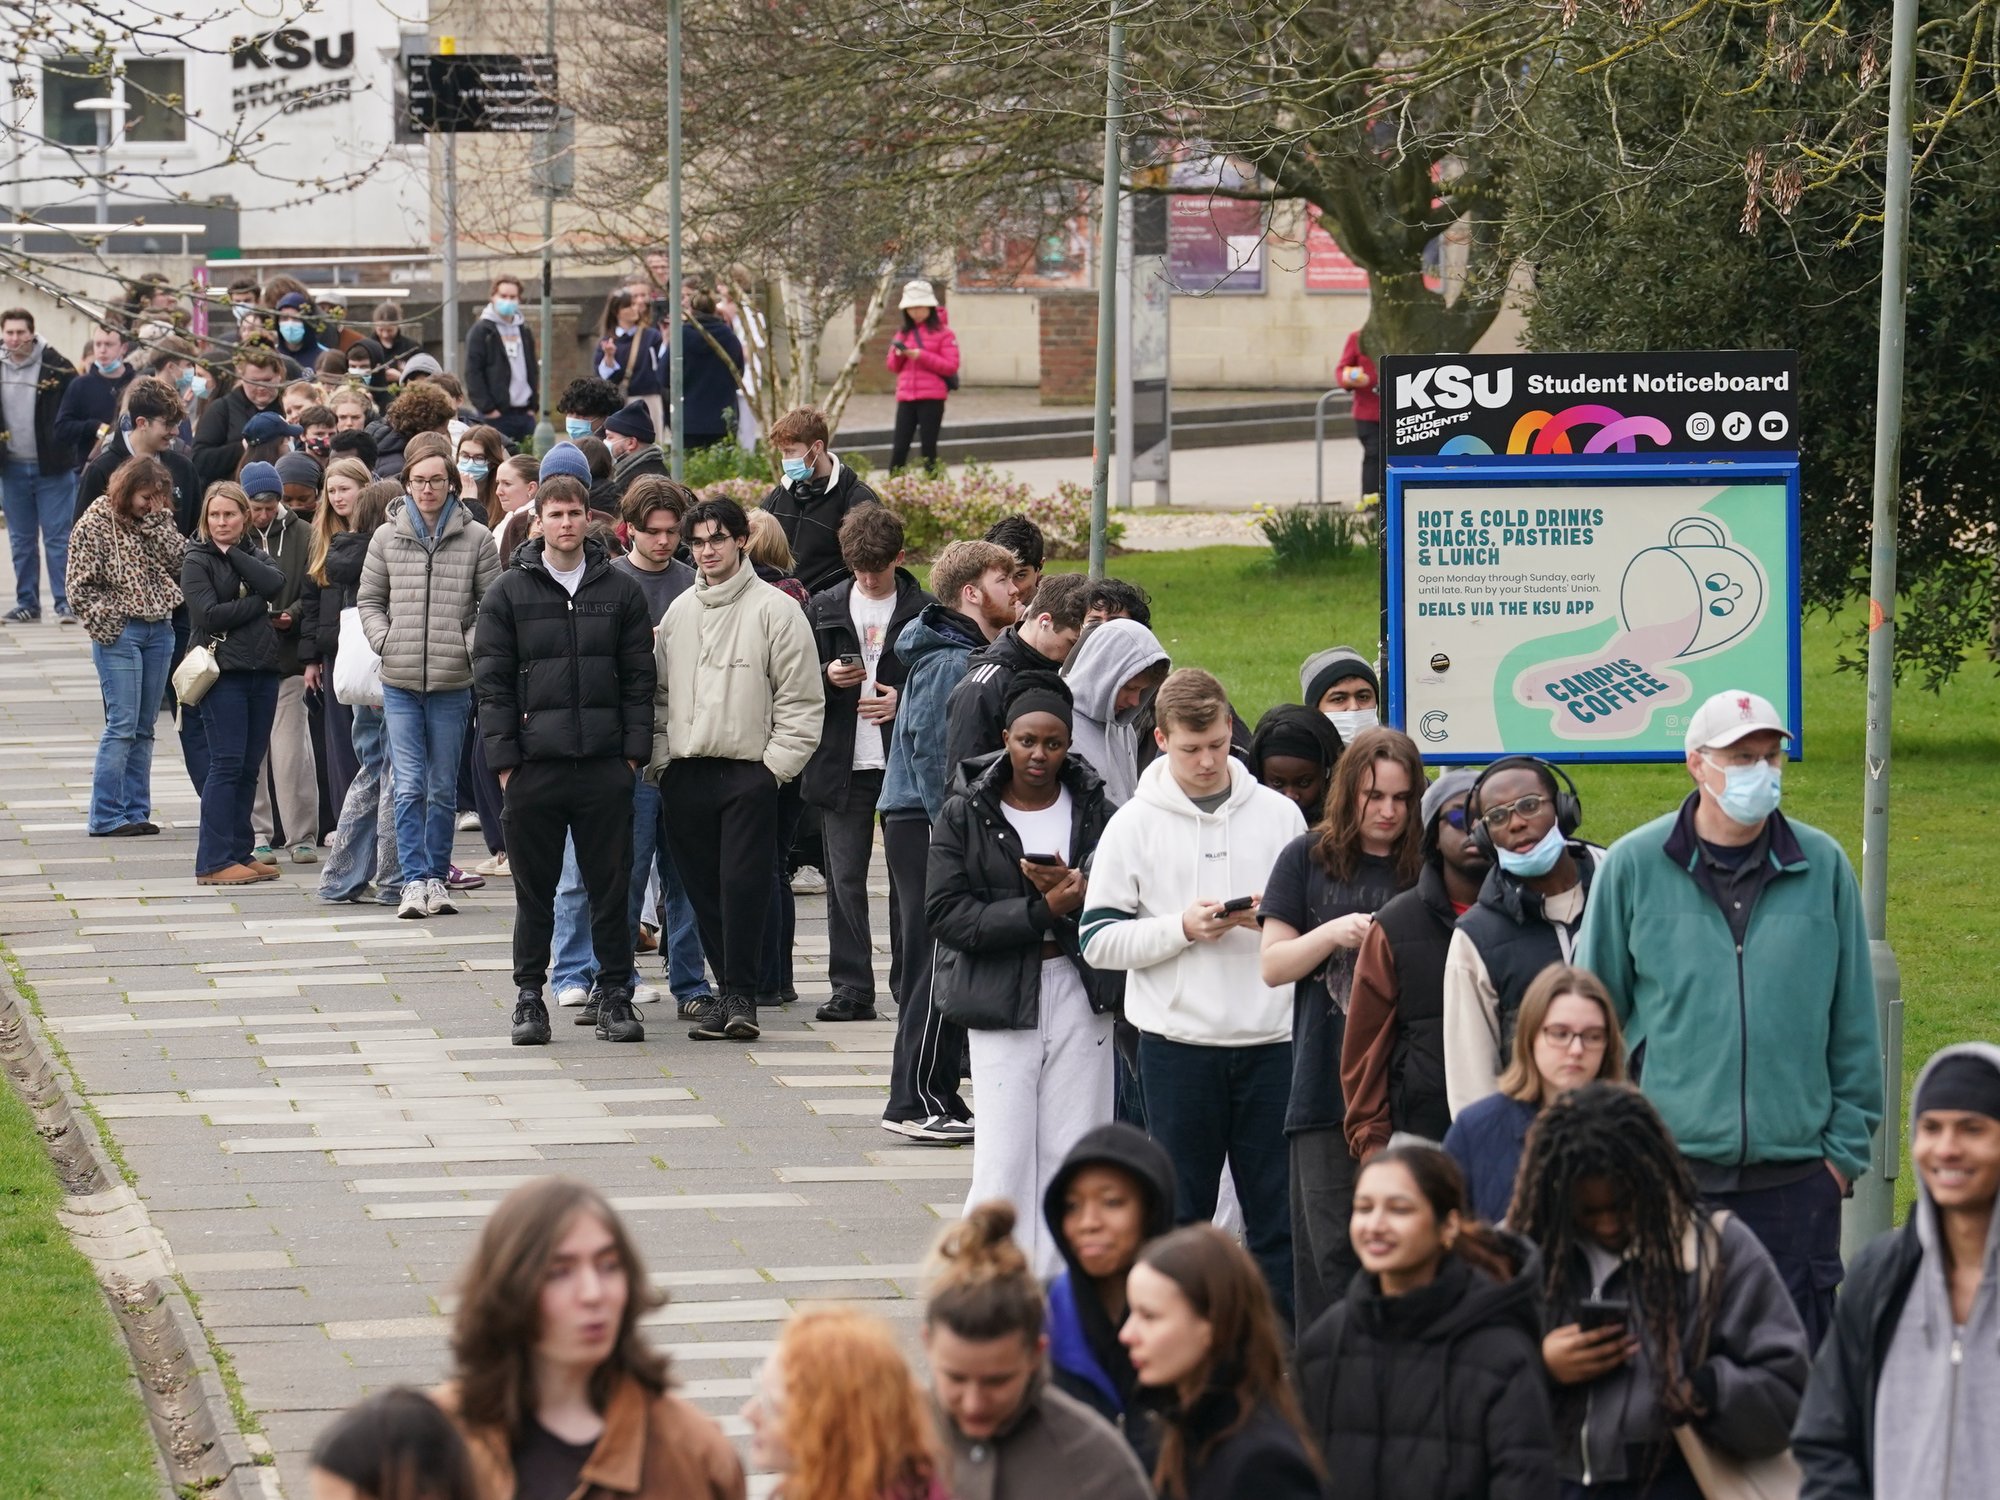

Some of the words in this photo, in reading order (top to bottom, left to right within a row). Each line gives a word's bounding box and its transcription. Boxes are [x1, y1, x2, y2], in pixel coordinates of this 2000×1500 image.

[231, 29, 354, 69] KSU
[231, 76, 290, 97] KENT
[283, 94, 352, 115] UNION
[1396, 365, 1513, 410] KSU
[1528, 373, 1627, 394] Student
[1633, 371, 1789, 393] Noticeboard
[1396, 410, 1436, 428] KENT
[1396, 411, 1472, 437] STUDENTS'
[1396, 428, 1440, 446] UNION
[1418, 510, 1454, 528] HOT
[1460, 510, 1474, 527] &
[1480, 509, 1529, 527] COLD
[1535, 508, 1604, 527] DRINKS
[1418, 529, 1496, 548] SNACKS,
[1503, 528, 1594, 546] PASTRIES
[1418, 549, 1431, 566] &
[1438, 547, 1500, 566] LUNCH
[1418, 574, 1445, 584] Open
[1446, 573, 1487, 585] Monday
[1488, 573, 1528, 585] through
[1529, 573, 1570, 584] Sunday,
[1570, 572, 1596, 583] early
[1418, 585, 1440, 595] until
[1441, 585, 1463, 595] late.
[1464, 586, 1483, 595] Run
[1485, 585, 1498, 596] by
[1499, 586, 1522, 597] your
[1523, 584, 1570, 594] Students'
[1571, 584, 1602, 594] Union.
[1418, 602, 1466, 617] DEALS
[1470, 602, 1494, 616] VIA
[1499, 602, 1528, 616] THE
[1533, 601, 1561, 616] KSU
[1566, 600, 1595, 615] APP
[1545, 658, 1643, 702] CAMPUS
[1567, 672, 1670, 724] COFFEE
